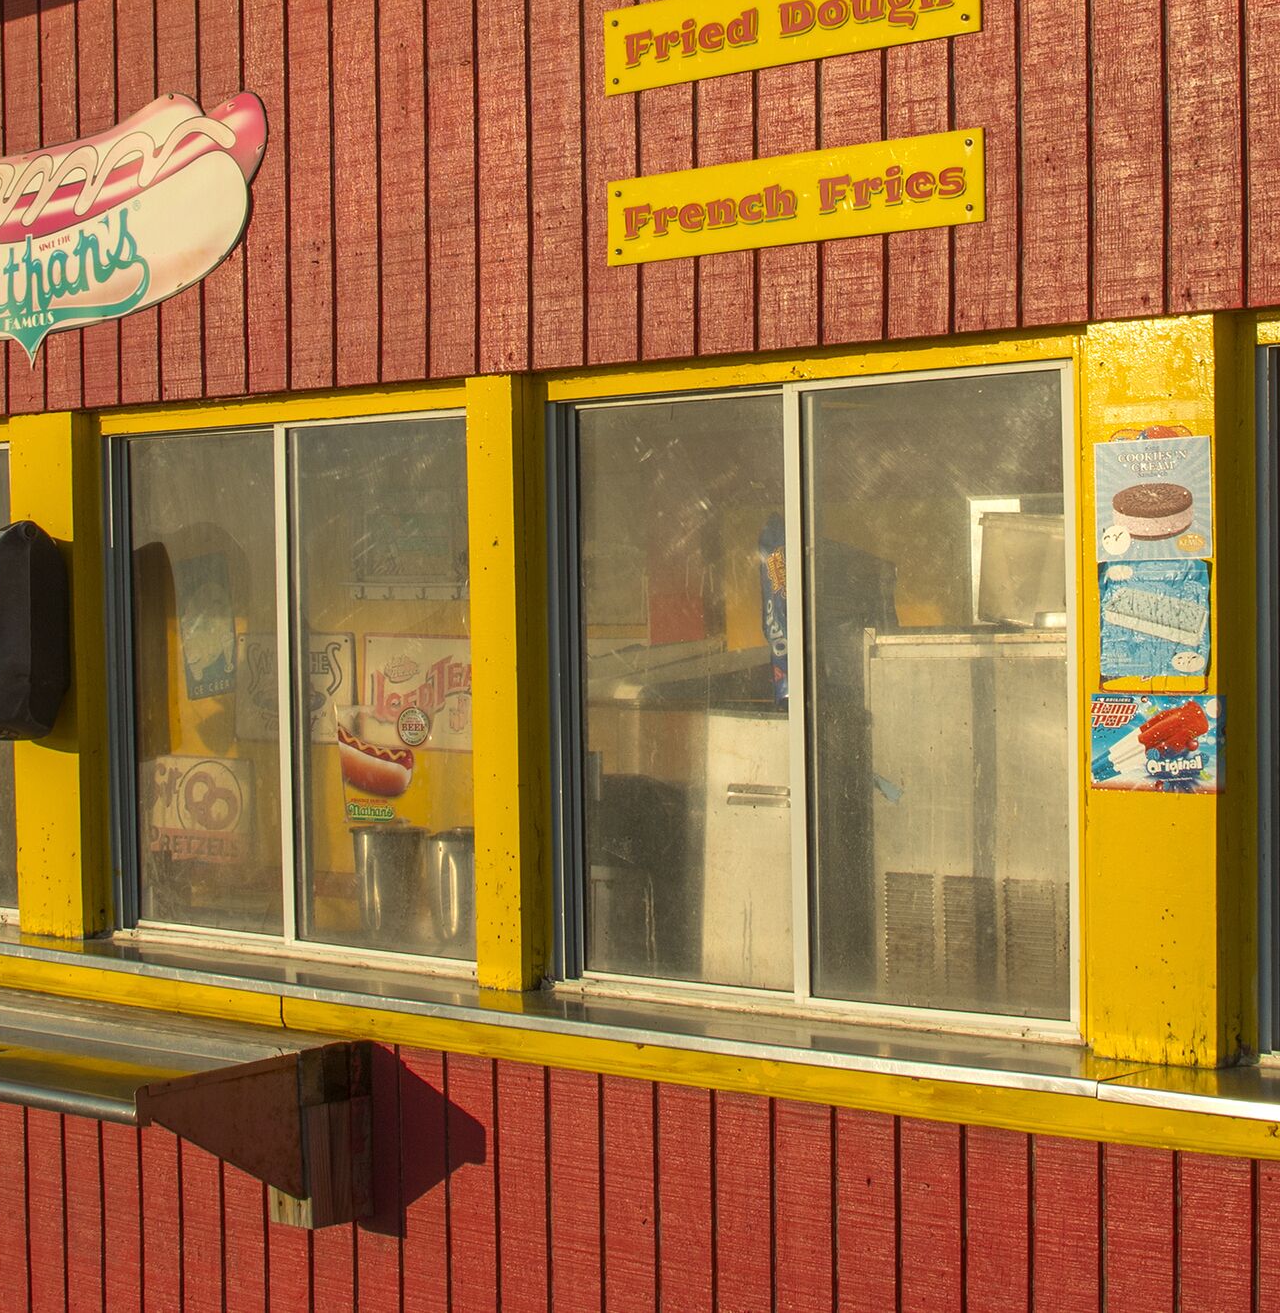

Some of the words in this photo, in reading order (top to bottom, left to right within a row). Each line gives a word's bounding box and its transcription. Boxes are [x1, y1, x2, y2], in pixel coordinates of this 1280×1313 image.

[624, 7, 759, 69] Fried
[623, 183, 799, 240] French
[817, 165, 967, 215] Fries
[4, 310, 55, 332] FAMOUS
[1117, 452, 1173, 465] COOKIES
[1130, 461, 1176, 473] CREAM
[1146, 755, 1204, 776] Original
